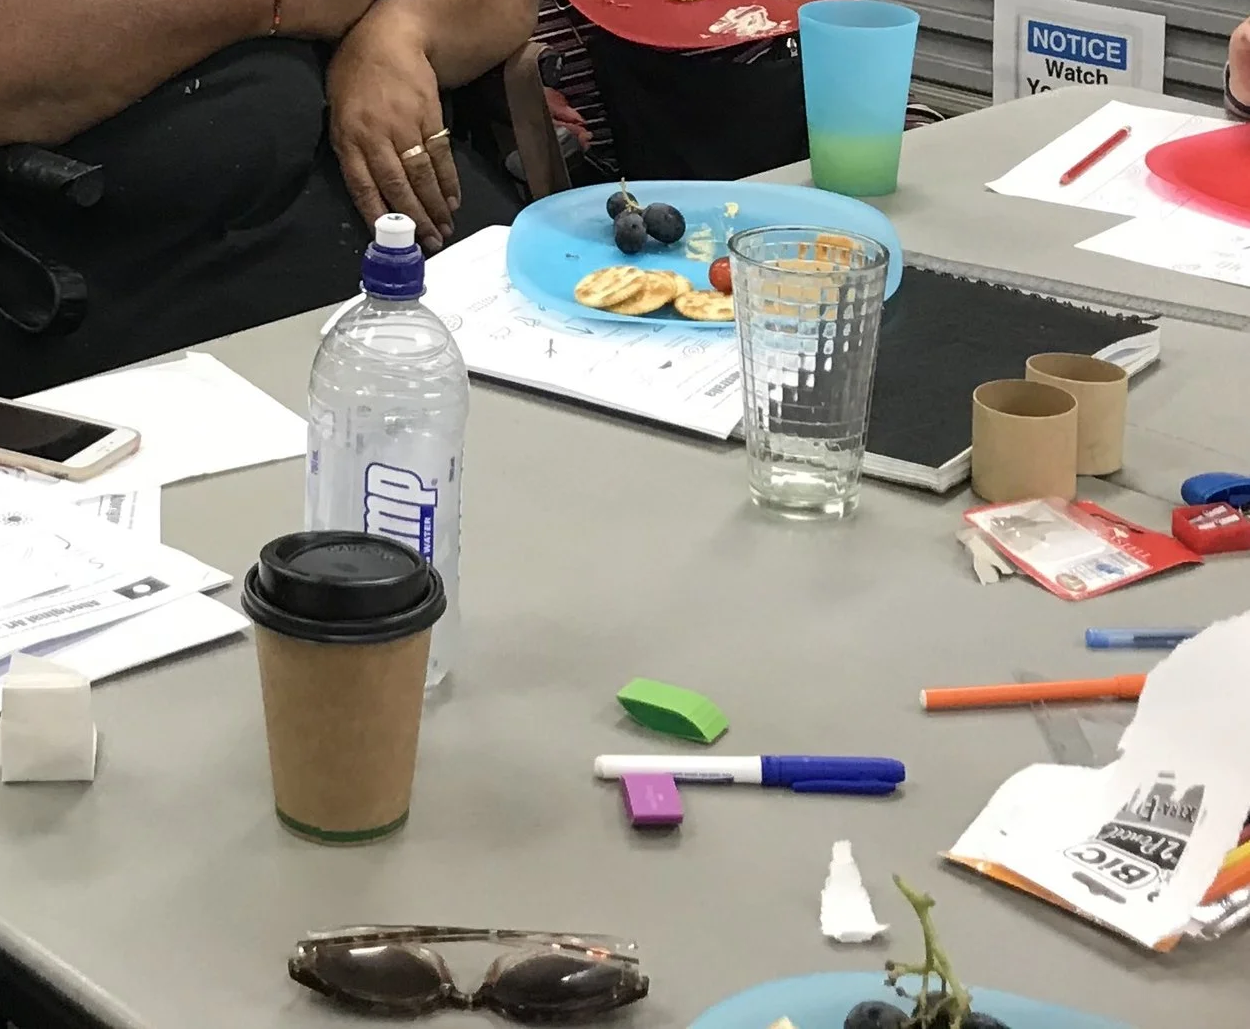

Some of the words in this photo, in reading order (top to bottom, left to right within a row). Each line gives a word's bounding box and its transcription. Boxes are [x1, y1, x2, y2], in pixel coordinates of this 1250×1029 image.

[1032, 26, 1122, 64] NOTICE
[1045, 58, 1109, 85] Watch
[362, 462, 439, 553] mp
[423, 516, 433, 554] WATER
[30, 599, 100, 628] Aboriginal
